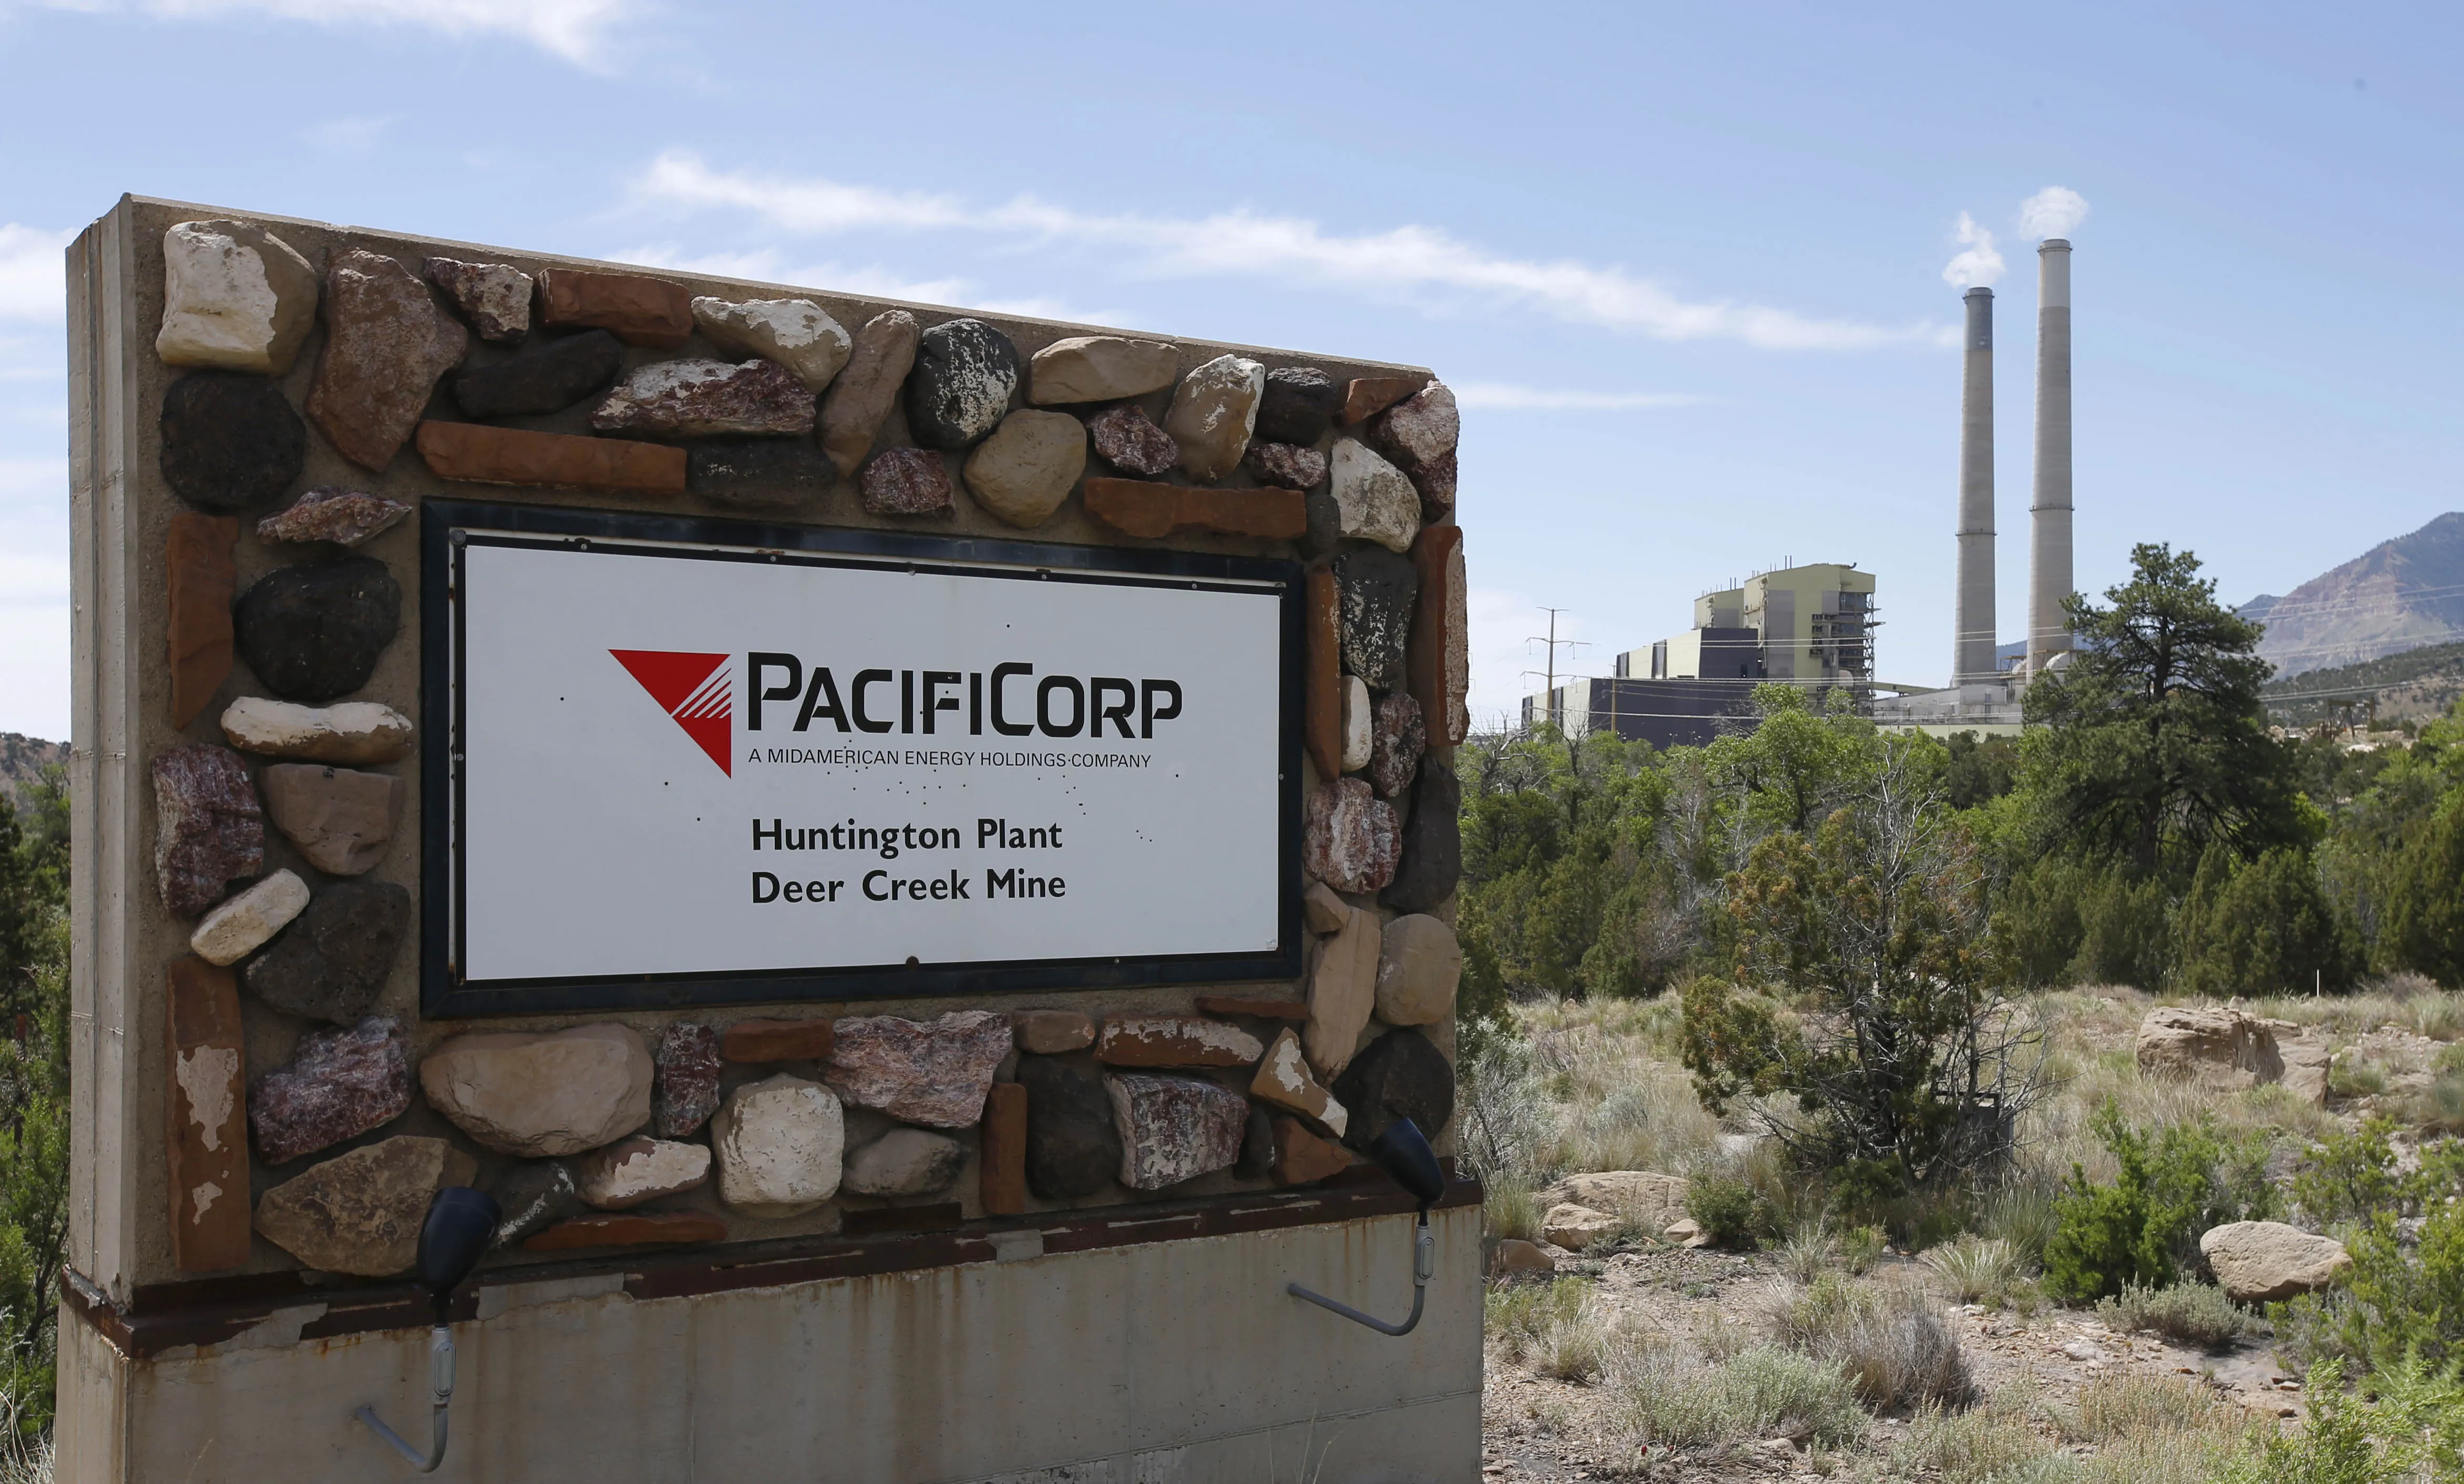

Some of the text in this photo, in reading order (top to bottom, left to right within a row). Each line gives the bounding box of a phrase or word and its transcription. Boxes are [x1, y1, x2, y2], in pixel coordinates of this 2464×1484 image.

[748, 748, 1151, 768] A MIDAMERICAN ENERGY HOLDINGS COMPANY
[752, 818, 1063, 859] Huntington Plant
[752, 868, 1065, 904] Deer Creek Mine
